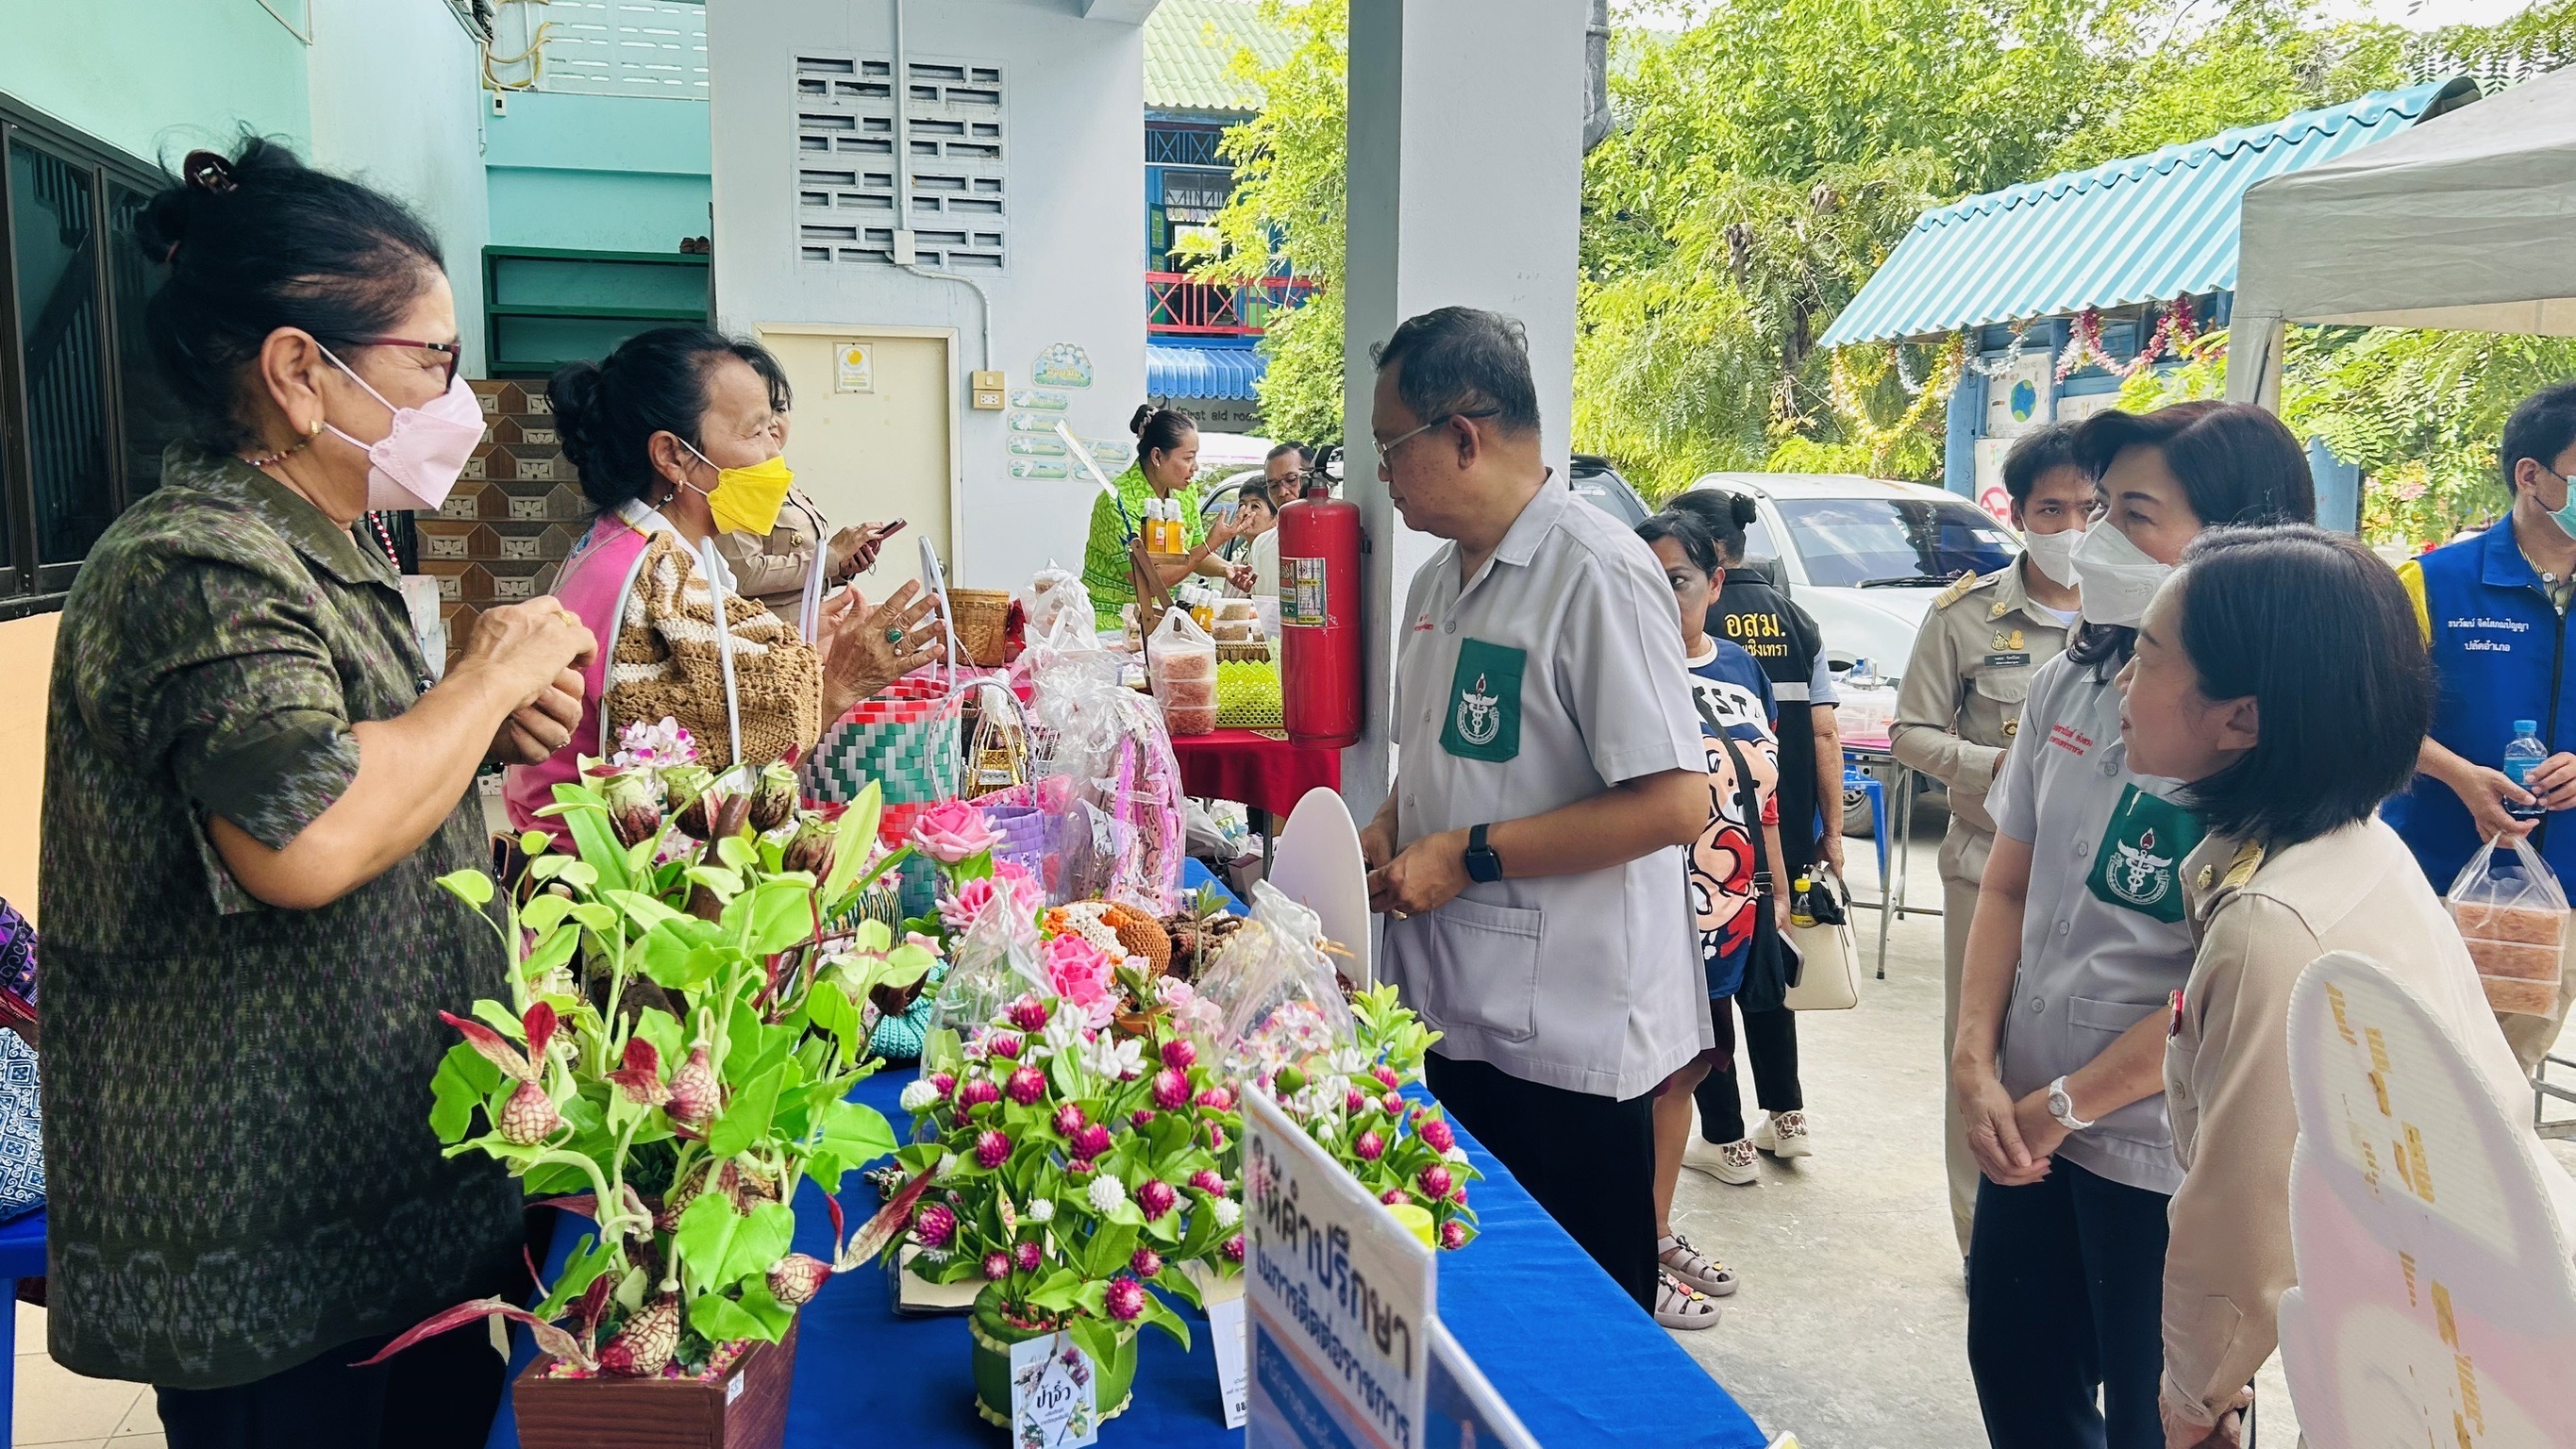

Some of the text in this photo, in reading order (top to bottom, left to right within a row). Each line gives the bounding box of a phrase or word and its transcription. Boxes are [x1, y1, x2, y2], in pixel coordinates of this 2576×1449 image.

[1211, 409, 1229, 421] aid
[1724, 612, 1786, 638] อสม.
[2464, 639, 2511, 652] ปลัดอำเภอ
[1253, 1134, 1412, 1380] ให้คำปรึกษา
[1255, 1226, 1411, 1449] ในการติดต่อราชการ
